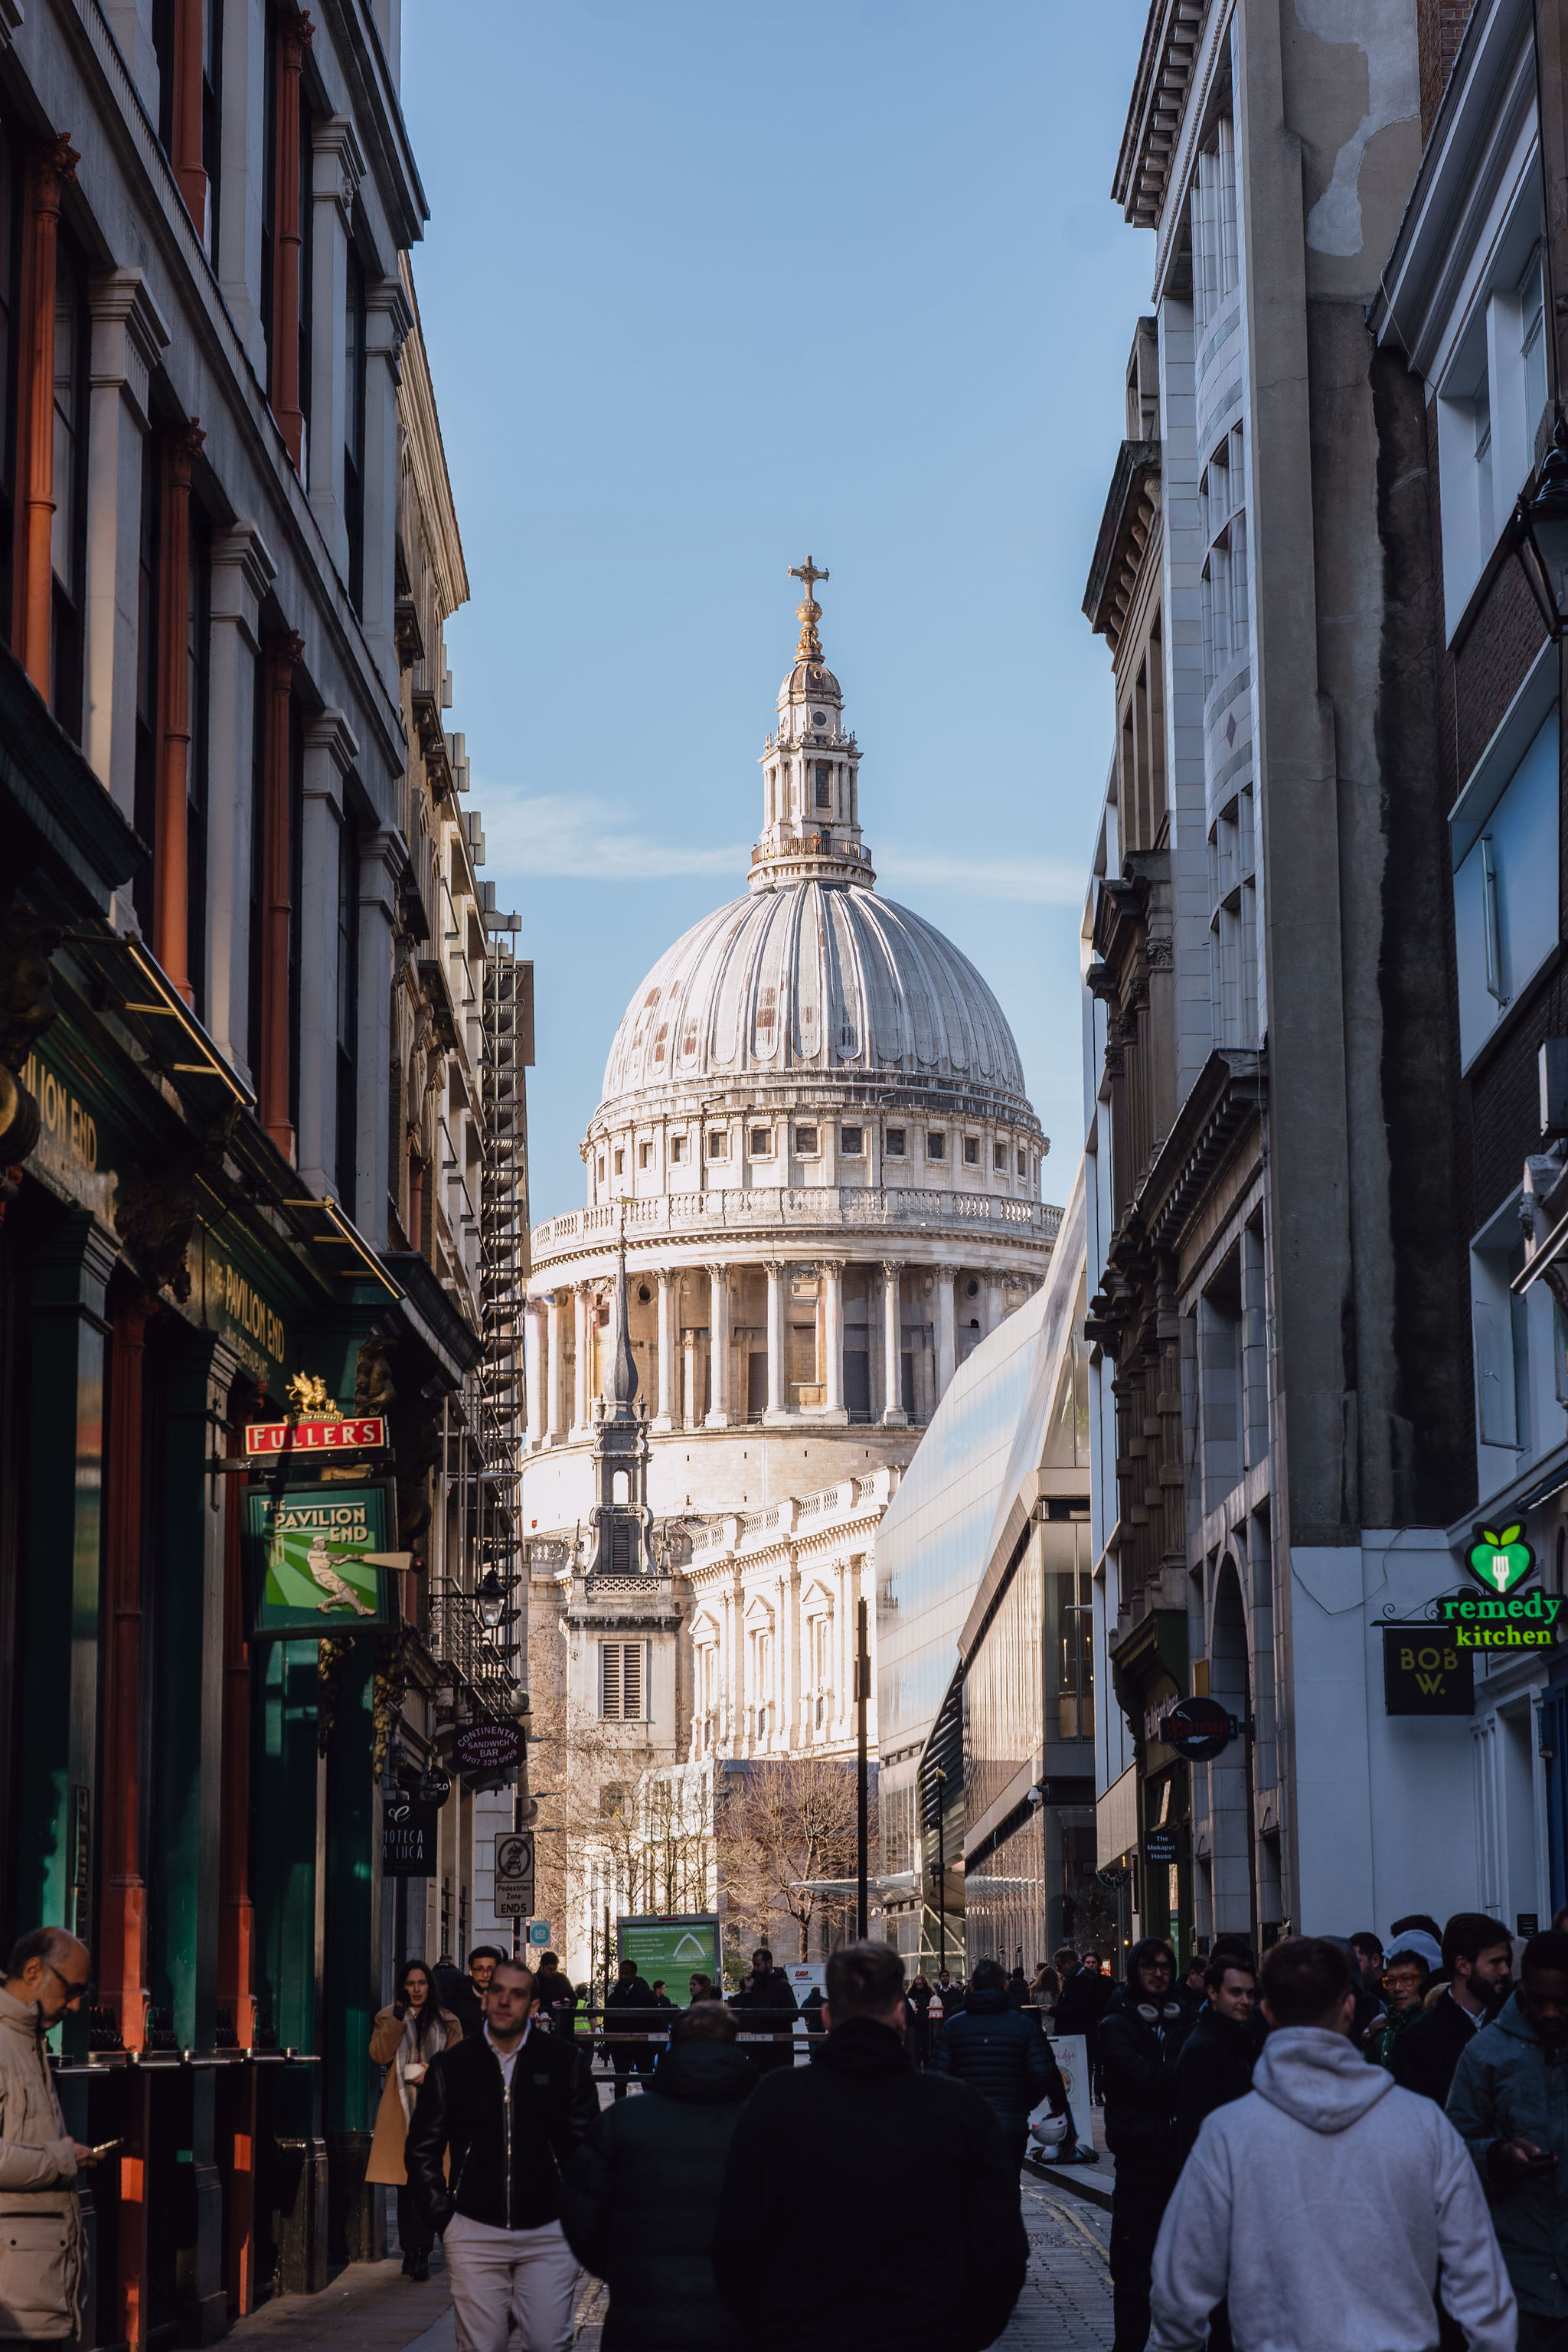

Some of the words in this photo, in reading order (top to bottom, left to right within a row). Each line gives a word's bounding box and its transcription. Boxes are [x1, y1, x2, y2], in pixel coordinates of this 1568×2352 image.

[70, 1097, 97, 1172] END
[225, 1263, 266, 1347] PAVILION
[267, 1308, 285, 1364] END
[253, 1422, 375, 1449] FULLER'S
[260, 1500, 286, 1512] THE
[274, 1507, 366, 1528] PAVILION
[329, 1525, 368, 1543] END
[1442, 1591, 1563, 1625] remedy
[1455, 1624, 1553, 1647] kitchen
[1400, 1647, 1459, 1671] BOB
[1414, 1672, 1446, 1696] W.
[457, 1726, 520, 1747] CONTINENTAL
[468, 1739, 510, 1749] SANDWICH
[462, 1753, 481, 1766] 0207
[498, 1749, 518, 1764] 0929
[479, 1748, 499, 1758] BAR
[501, 1903, 527, 1913] ENDS
